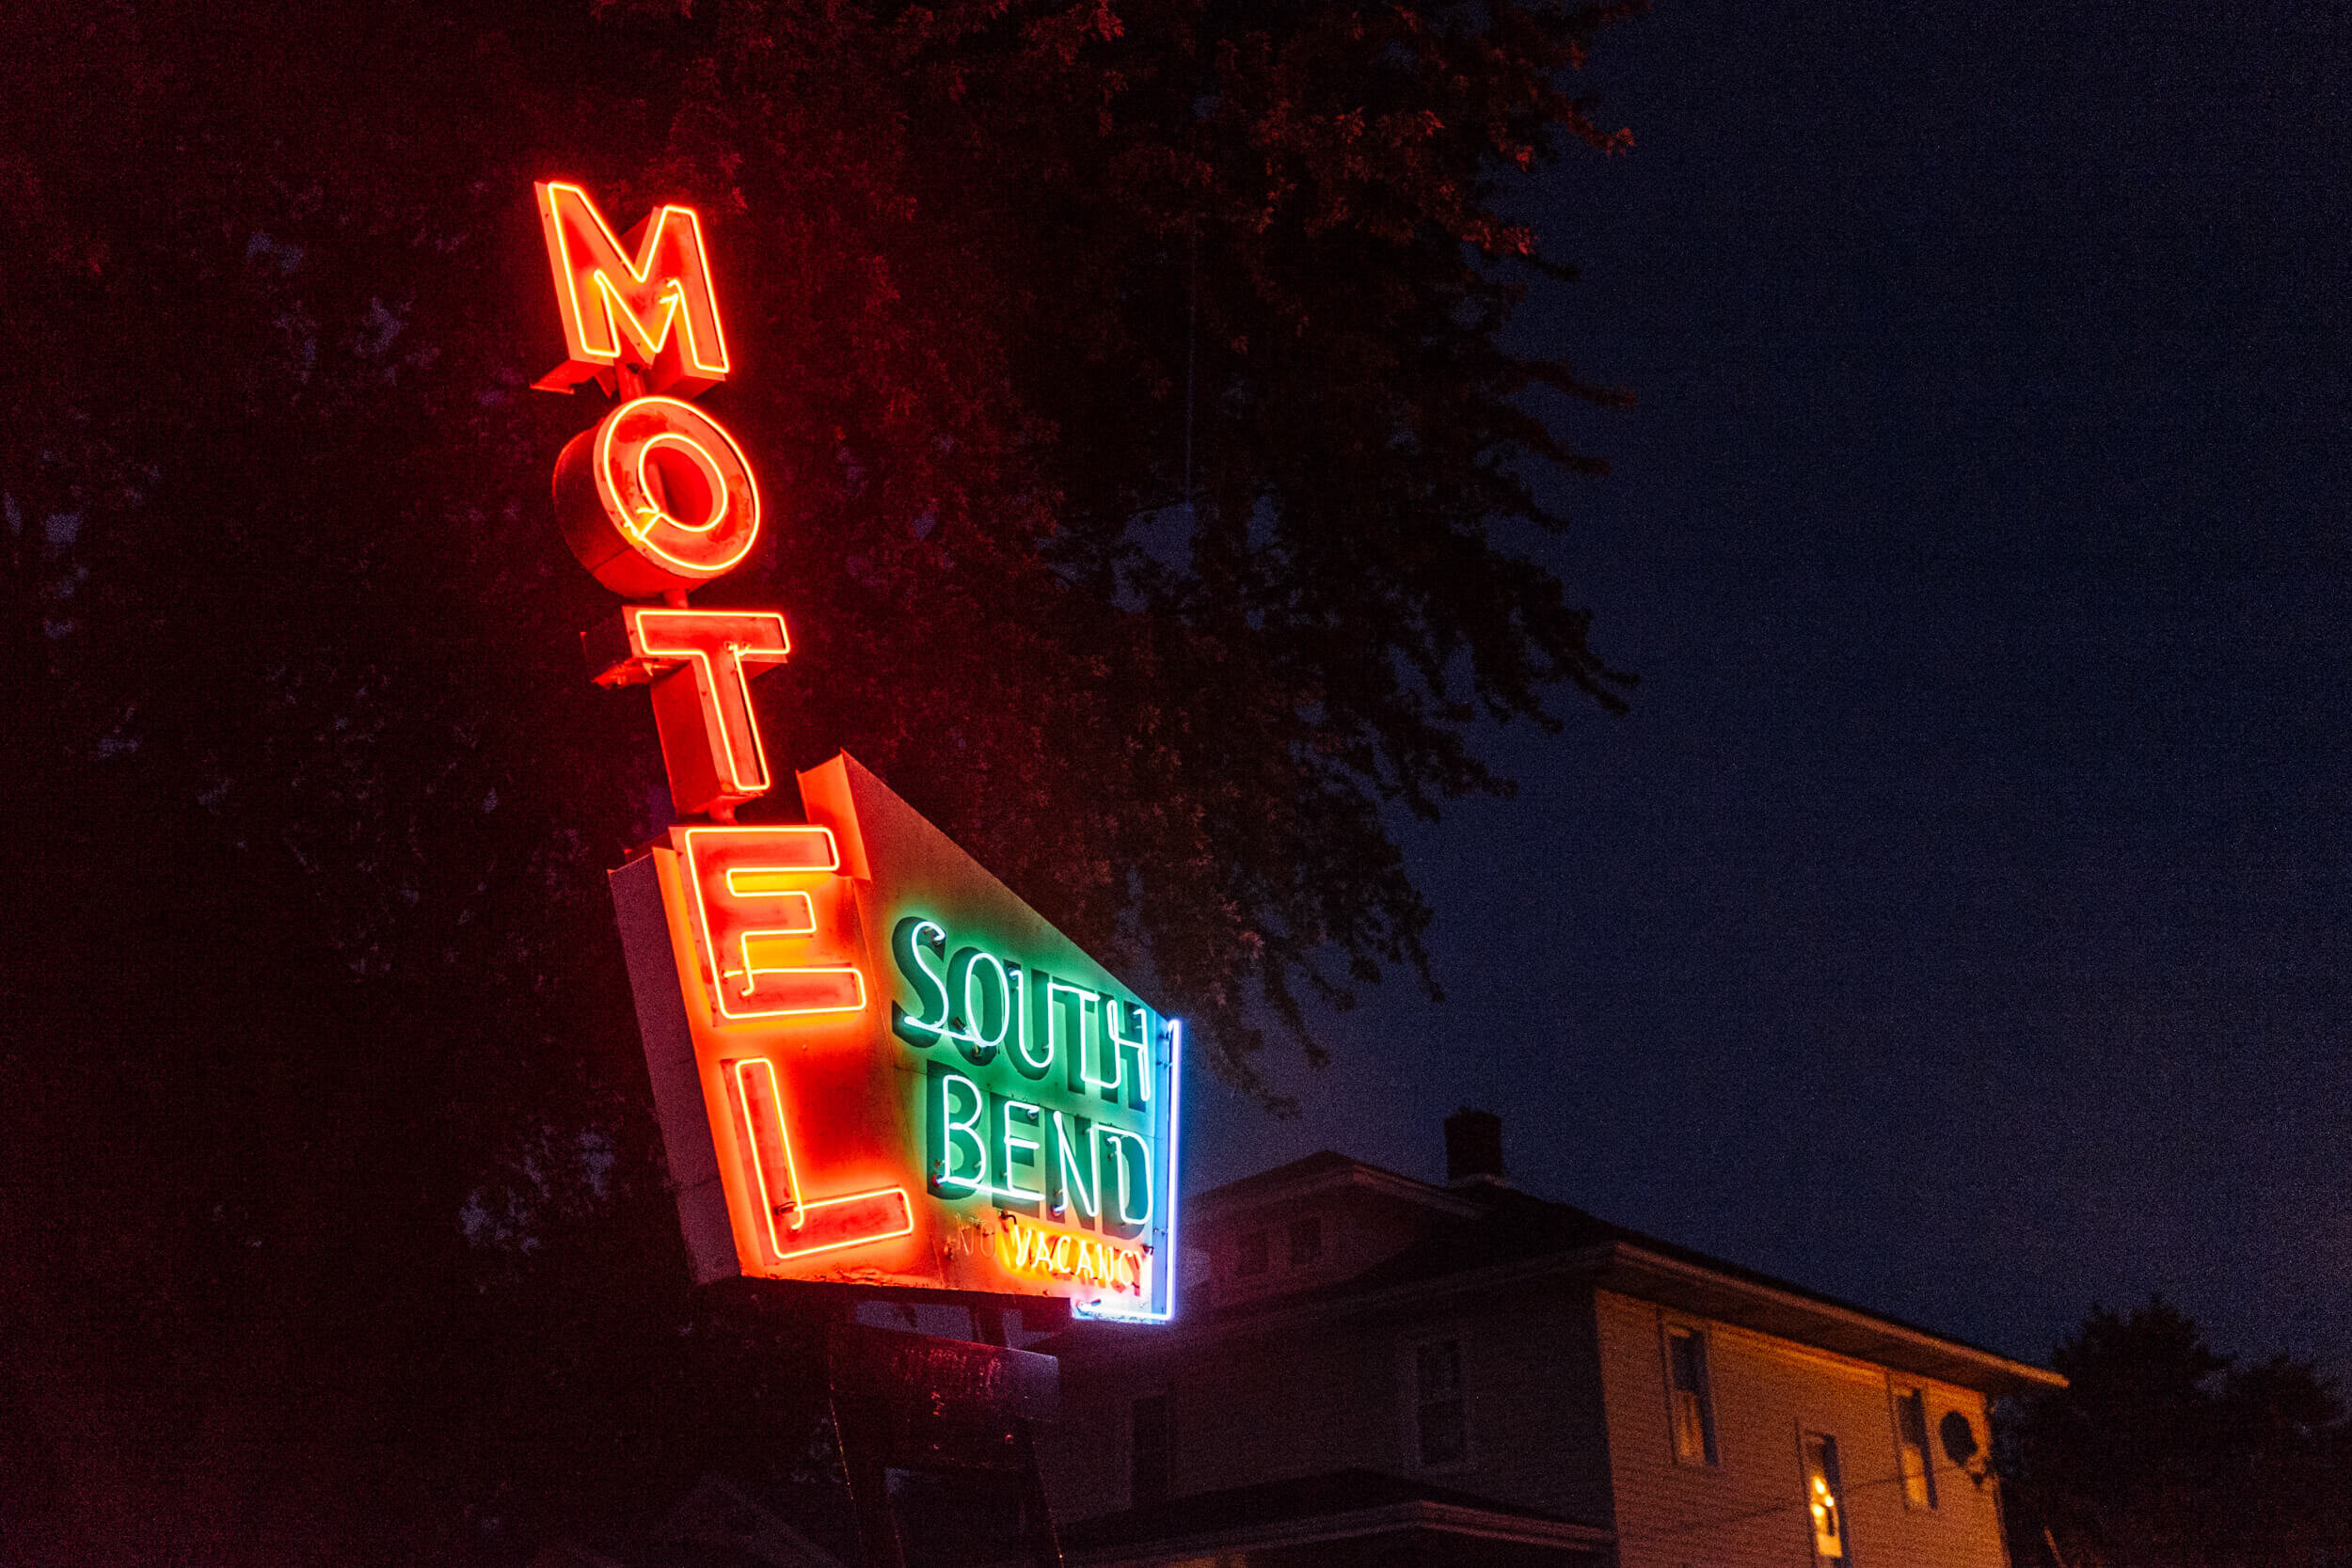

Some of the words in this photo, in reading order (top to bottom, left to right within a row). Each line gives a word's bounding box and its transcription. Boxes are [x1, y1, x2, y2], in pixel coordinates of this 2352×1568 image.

[534, 181, 915, 1263] MOTEL
[893, 916, 1151, 1112] SOUTH
[927, 1061, 1153, 1239] BEND
[955, 1212, 997, 1257] NO
[1007, 1222, 1154, 1293] VACANCY
